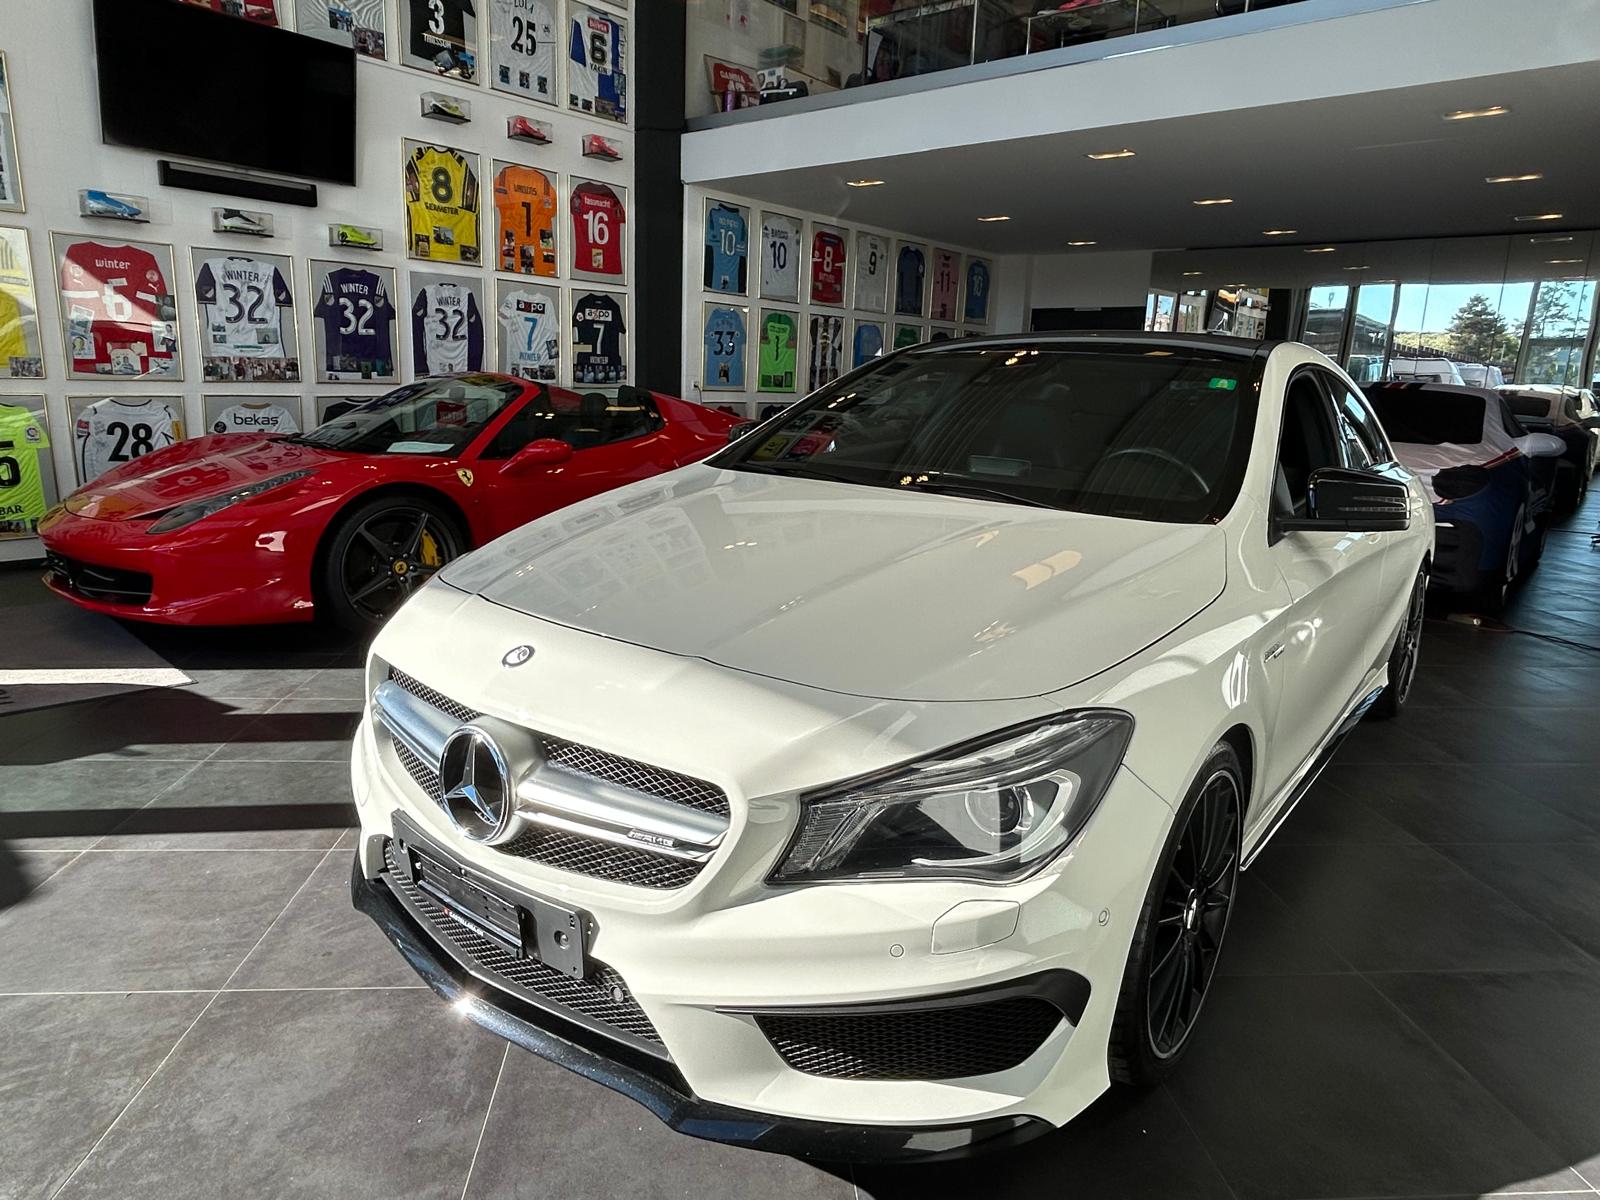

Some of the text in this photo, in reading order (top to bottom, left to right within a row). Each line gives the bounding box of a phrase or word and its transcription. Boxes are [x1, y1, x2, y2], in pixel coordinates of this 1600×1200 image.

[428, 0, 445, 34] 3
[511, 16, 536, 56] 25
[589, 31, 607, 65] 6
[431, 166, 453, 203] 8
[521, 202, 532, 237] 1
[583, 210, 609, 245] 16
[720, 229, 736, 256] 10
[770, 241, 787, 270] 10
[823, 246, 833, 272] 8
[95, 258, 131, 270] winter
[225, 270, 259, 282] WINTER
[868, 251, 877, 275] 9
[223, 283, 268, 324] 32
[340, 283, 369, 295] WINTER
[436, 296, 461, 306] WINTER
[338, 297, 376, 335] 32
[435, 308, 467, 341] 32
[524, 316, 537, 352] 7
[593, 323, 605, 355] 7
[713, 331, 736, 356] 33
[106, 421, 154, 462] 28
